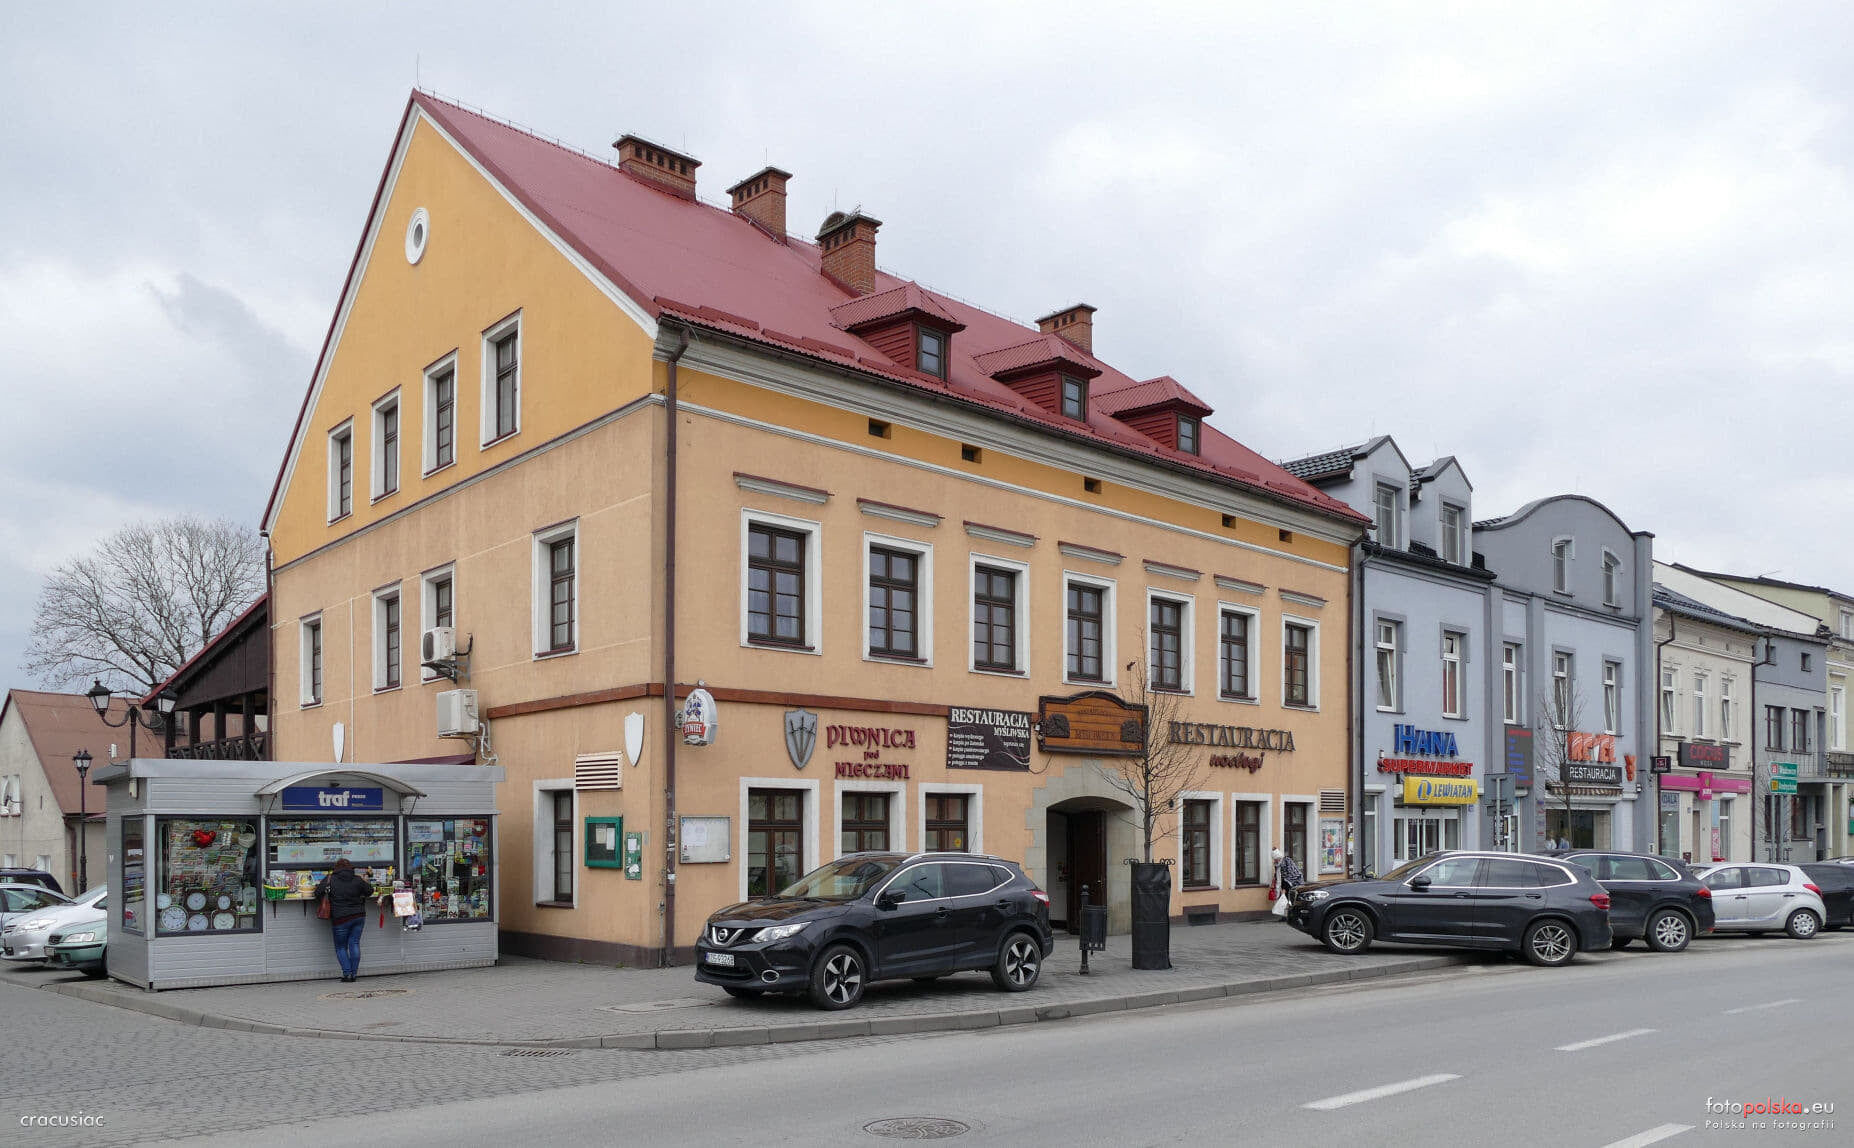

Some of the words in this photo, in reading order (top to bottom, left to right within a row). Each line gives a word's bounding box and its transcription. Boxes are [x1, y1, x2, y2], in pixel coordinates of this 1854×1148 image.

[950, 708, 1030, 728] RESTAURACJA
[826, 725, 917, 749] PIWNICA
[993, 726, 1030, 739] MYŚLIWSKA
[1168, 721, 1296, 754] RESTAURACJA
[1394, 723, 1459, 757] HANA
[863, 750, 880, 761] pod
[1209, 752, 1265, 774] noclegi
[834, 762, 911, 780] MIECZAMI
[1378, 758, 1474, 776] SUPERMARKET
[1569, 766, 1616, 781] RESTAURACJA
[318, 790, 350, 807] traf
[1433, 782, 1473, 799] LEWIATAN
